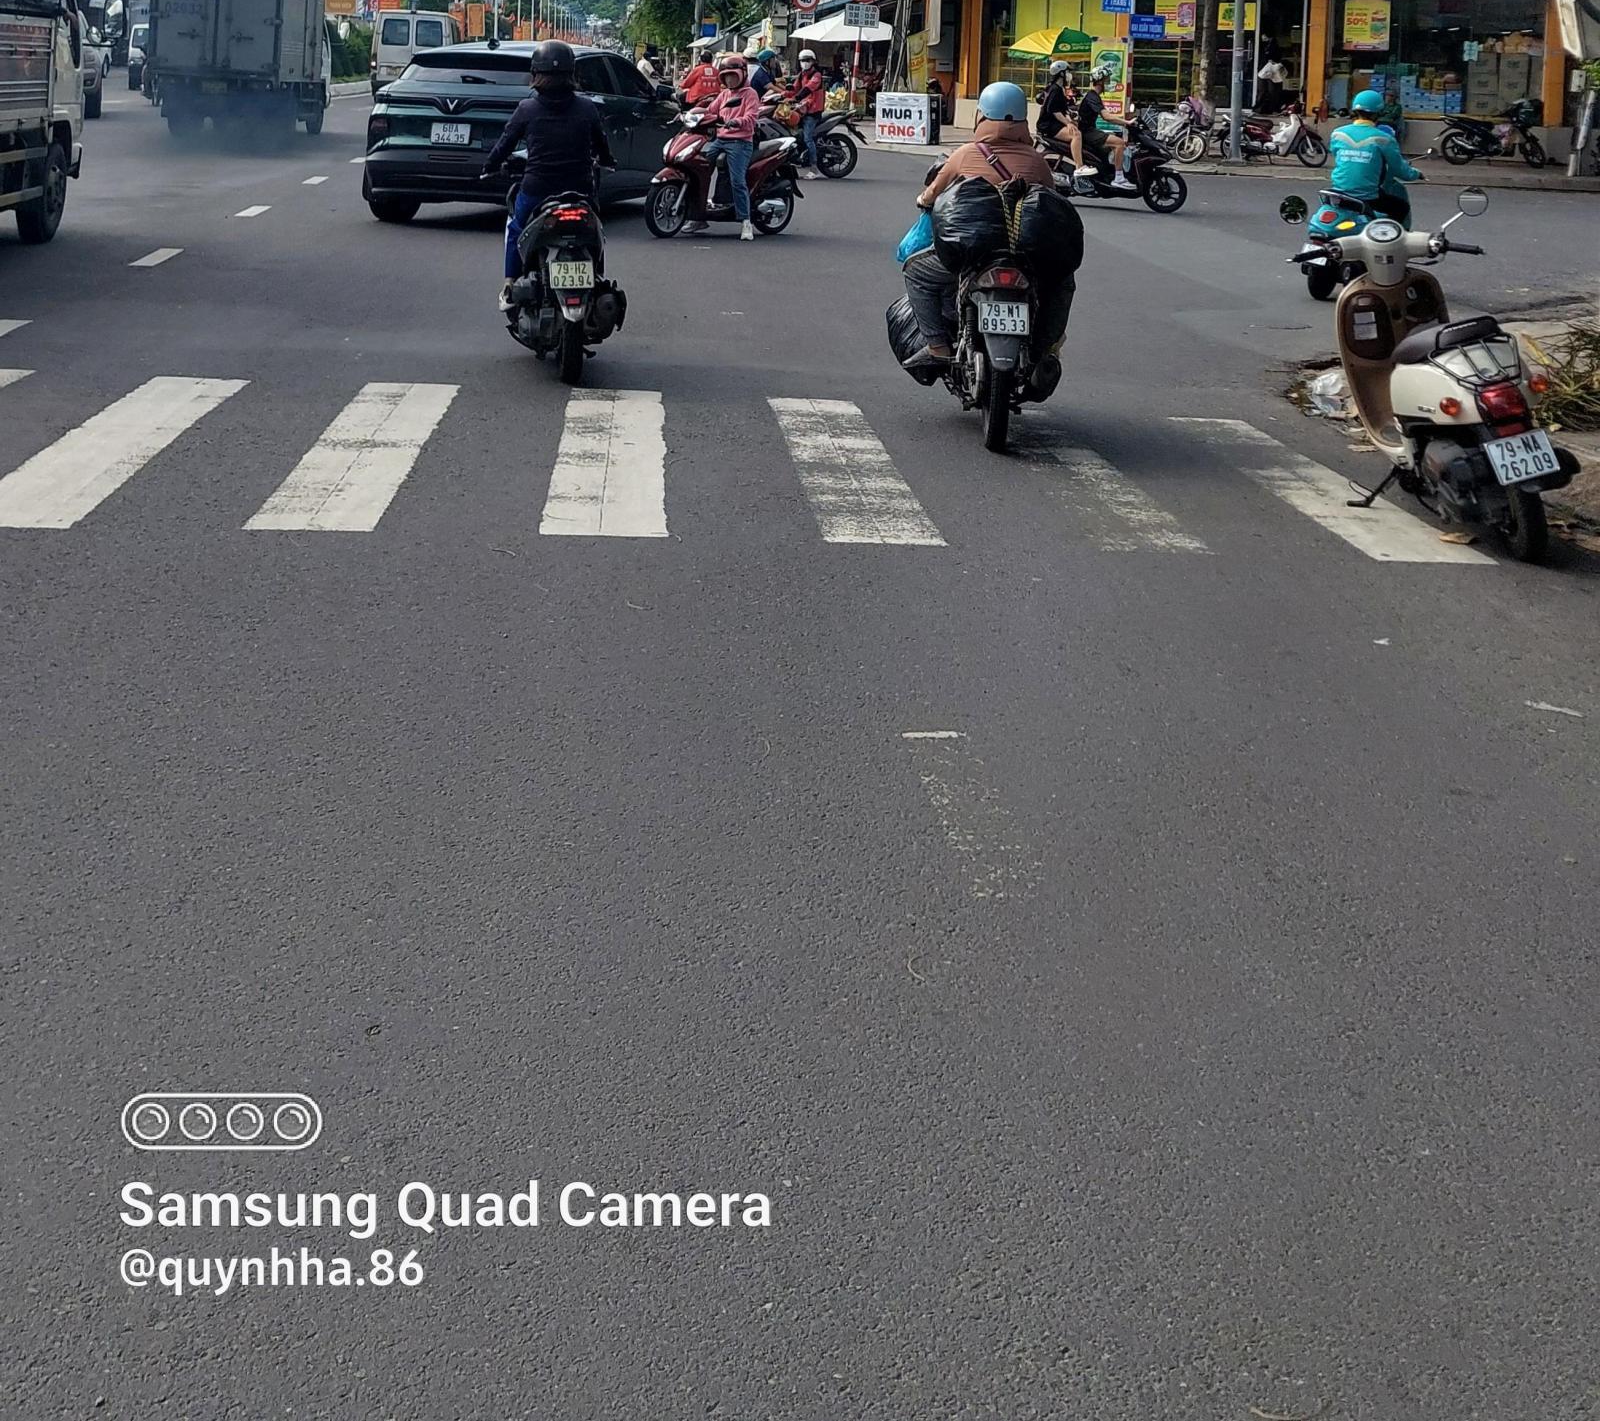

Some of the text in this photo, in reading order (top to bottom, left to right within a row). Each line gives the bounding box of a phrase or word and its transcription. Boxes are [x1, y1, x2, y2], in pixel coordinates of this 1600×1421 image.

[881, 108, 923, 120] MUA 1
[920, 126, 926, 138] 1
[553, 275, 592, 287] 023.94
[987, 303, 1020, 318] 79-N1
[982, 317, 1026, 333] 895.33
[1496, 435, 1542, 460] 79-NA
[1501, 452, 1554, 481] 262.09
